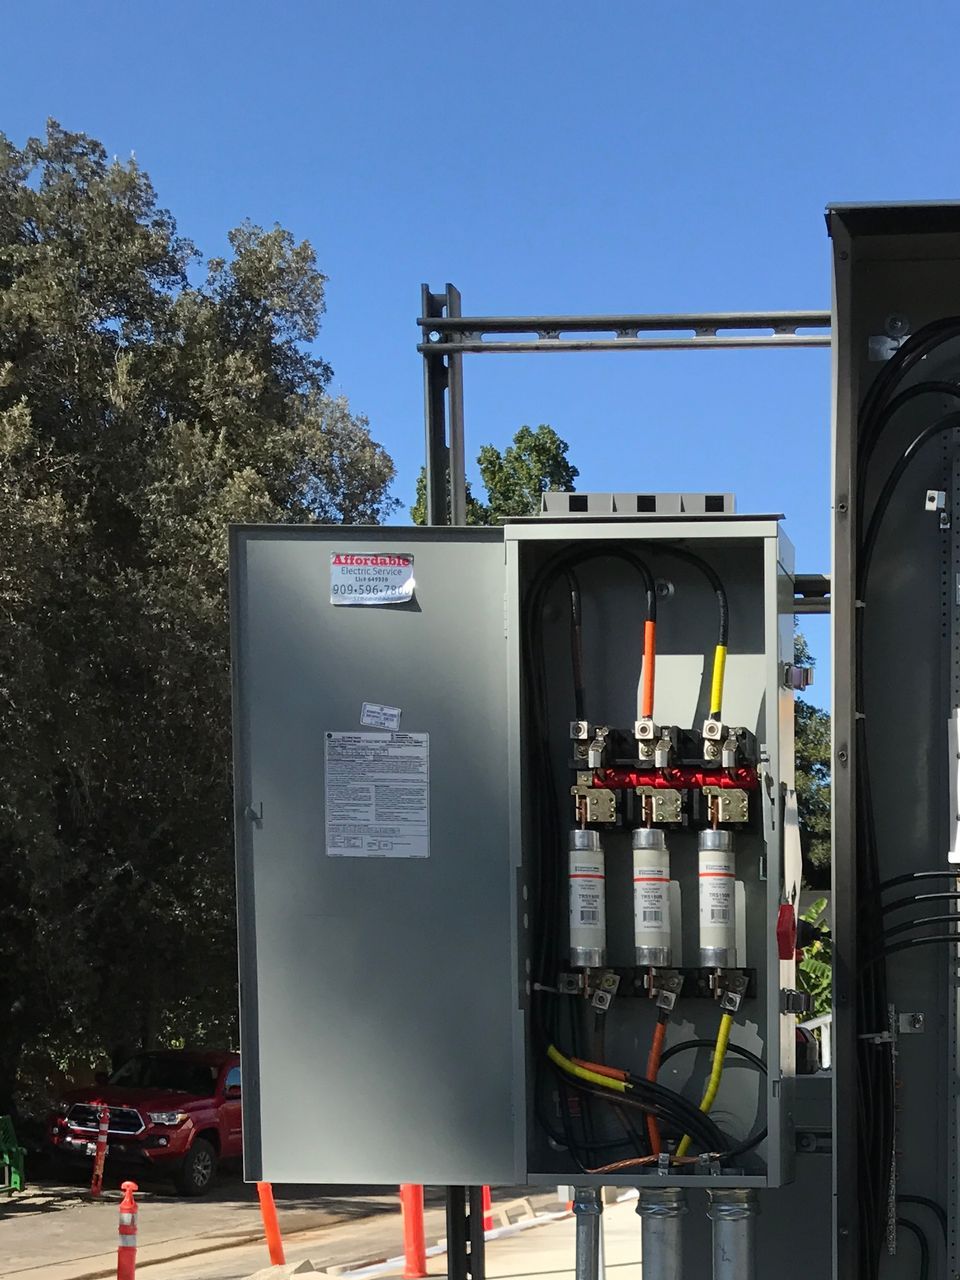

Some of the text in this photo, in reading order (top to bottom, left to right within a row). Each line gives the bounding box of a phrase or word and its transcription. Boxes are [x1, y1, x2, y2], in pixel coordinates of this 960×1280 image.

[332, 554, 410, 567] Affordable
[341, 567, 403, 576] Electric Service
